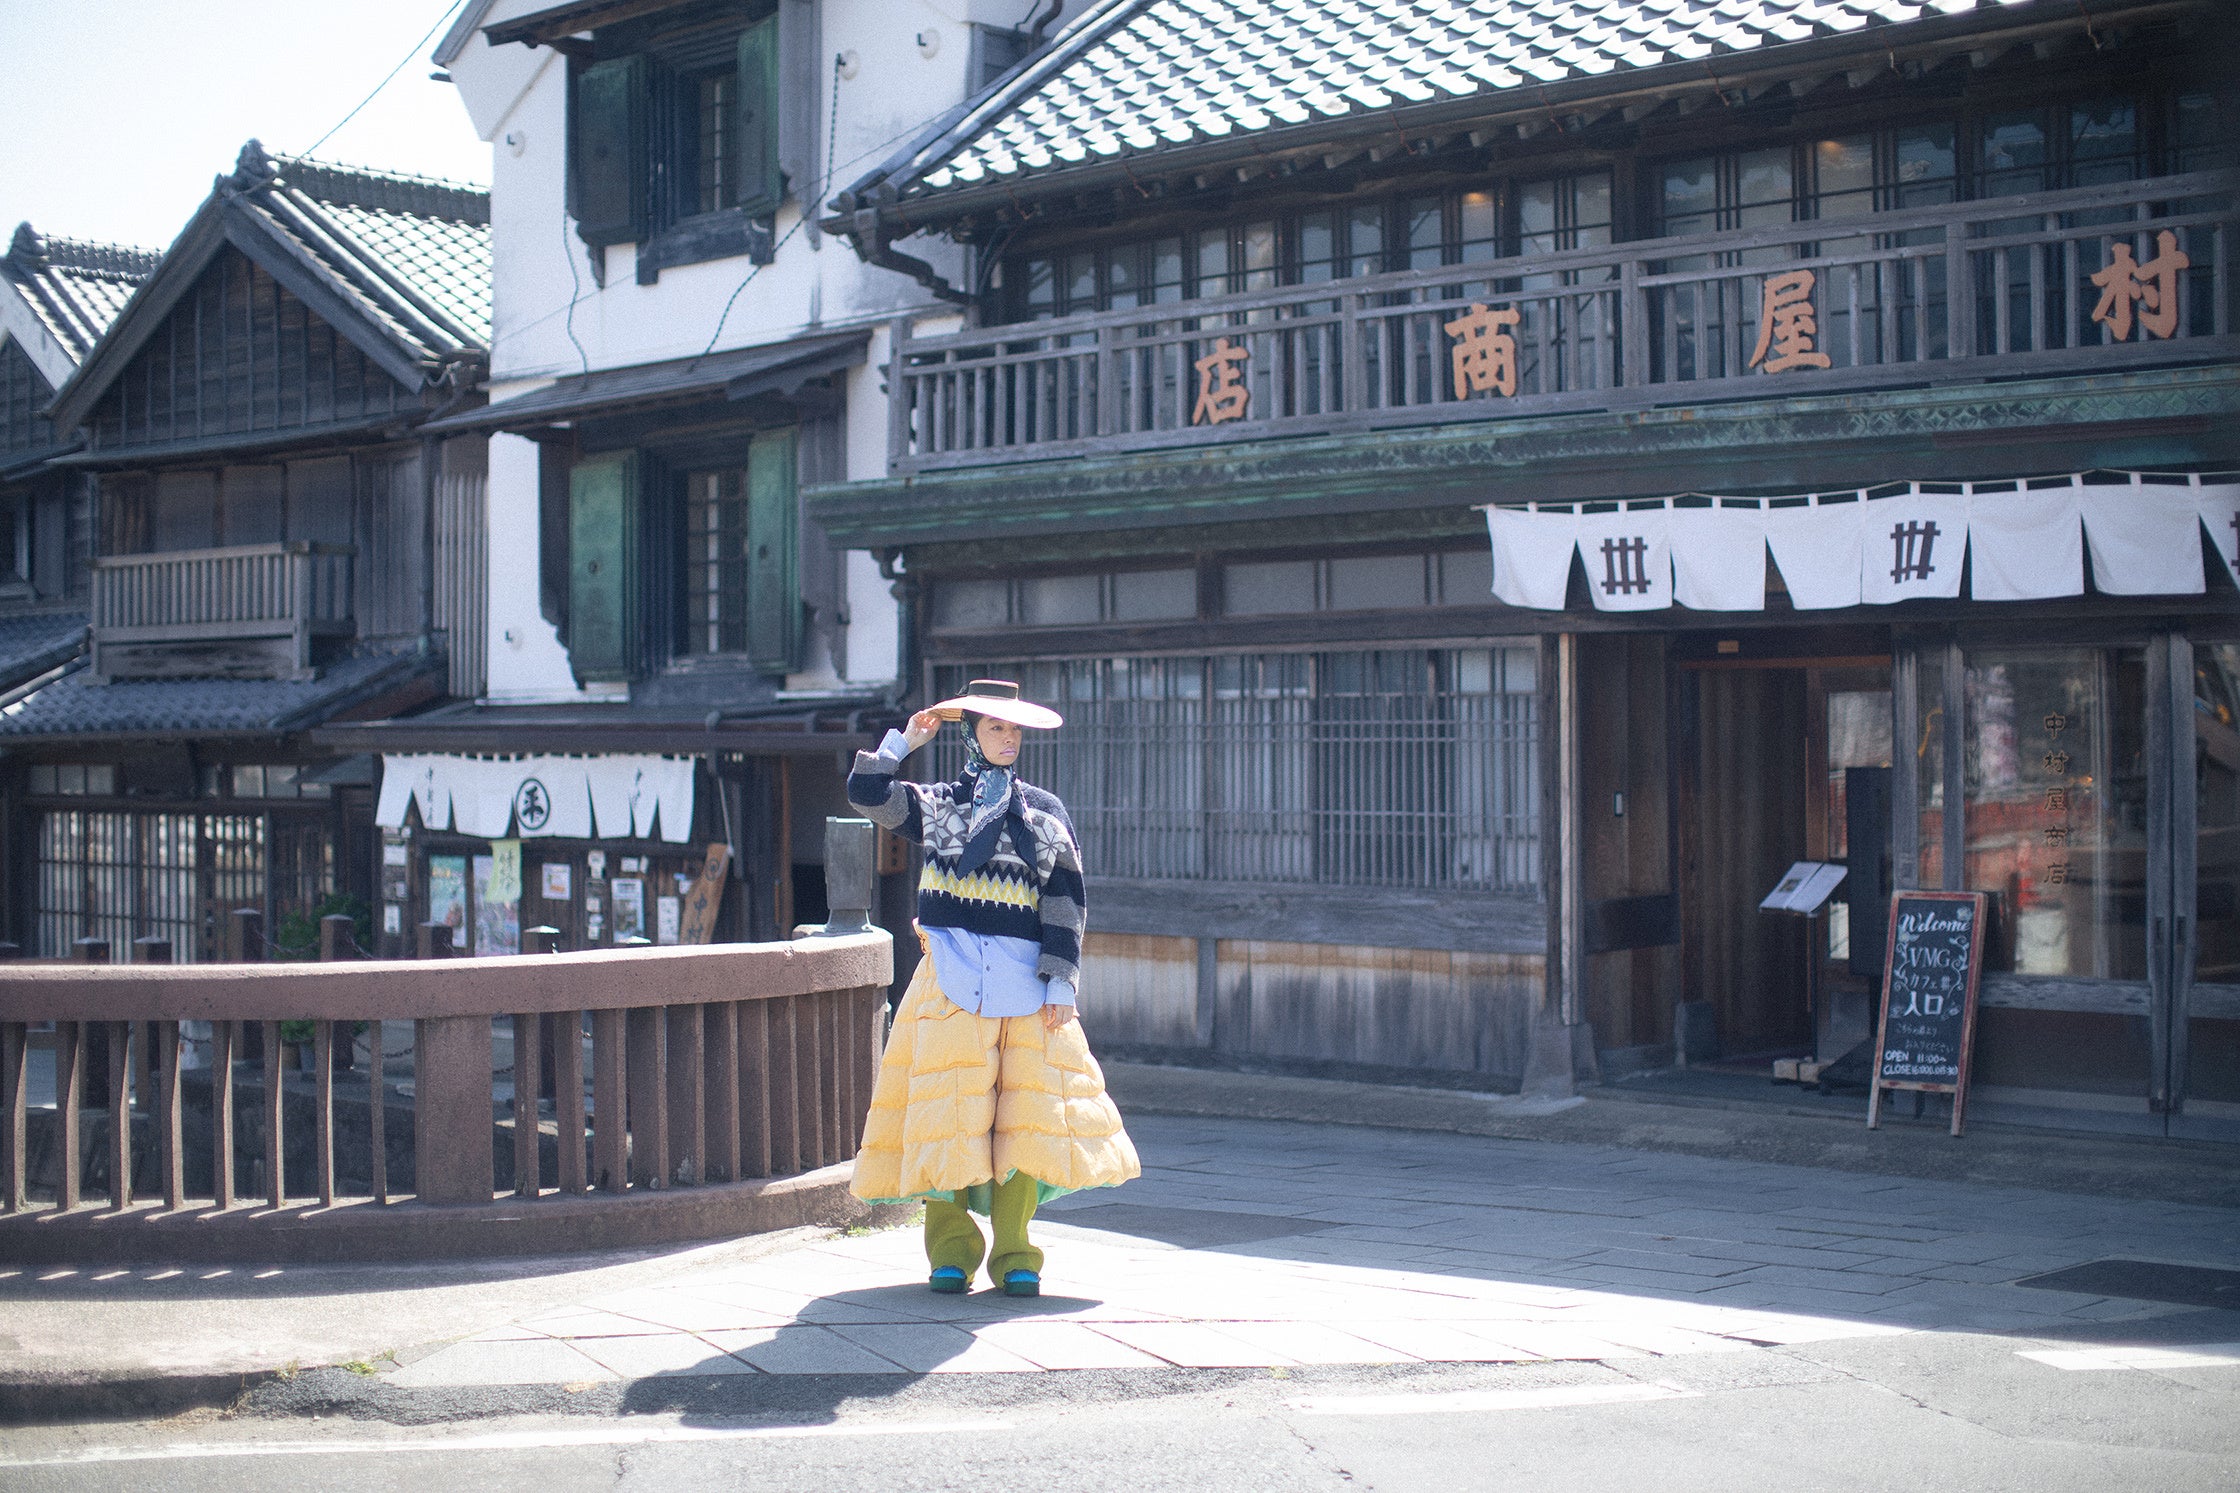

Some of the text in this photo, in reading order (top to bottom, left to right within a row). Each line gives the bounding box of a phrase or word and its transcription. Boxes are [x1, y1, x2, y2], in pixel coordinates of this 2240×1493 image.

[1192, 229, 2190, 426] 村 屋 商 店
[2042, 711, 2070, 885] 中村屋商店
[1898, 911, 1971, 933] Welcome
[1909, 947, 1951, 968] VMG
[1903, 990, 1944, 1016] 入口
[1885, 1050, 1909, 1062] OPEN
[1883, 1063, 1911, 1075] CLOSE
